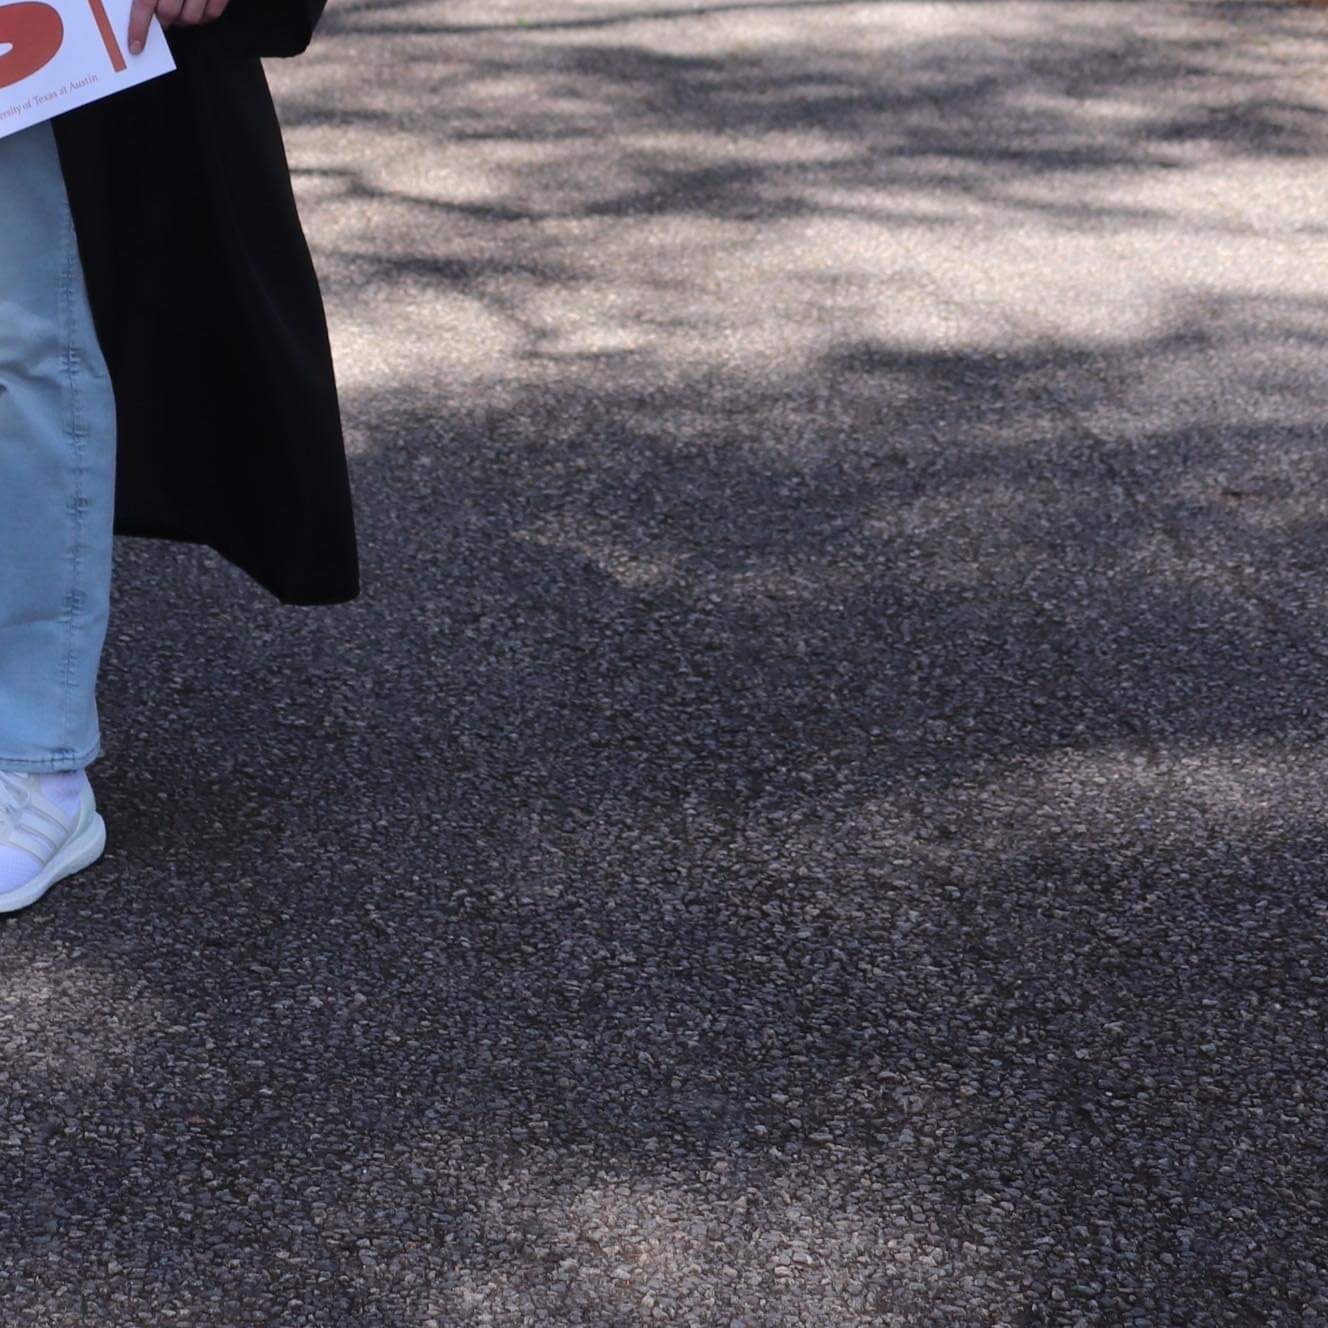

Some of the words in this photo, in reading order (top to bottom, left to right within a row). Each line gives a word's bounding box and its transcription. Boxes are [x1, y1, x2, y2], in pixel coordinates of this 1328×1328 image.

[22, 98, 33, 112] of
[33, 92, 58, 107] Texas
[59, 86, 69, 97] at
[70, 74, 99, 93] Austin
